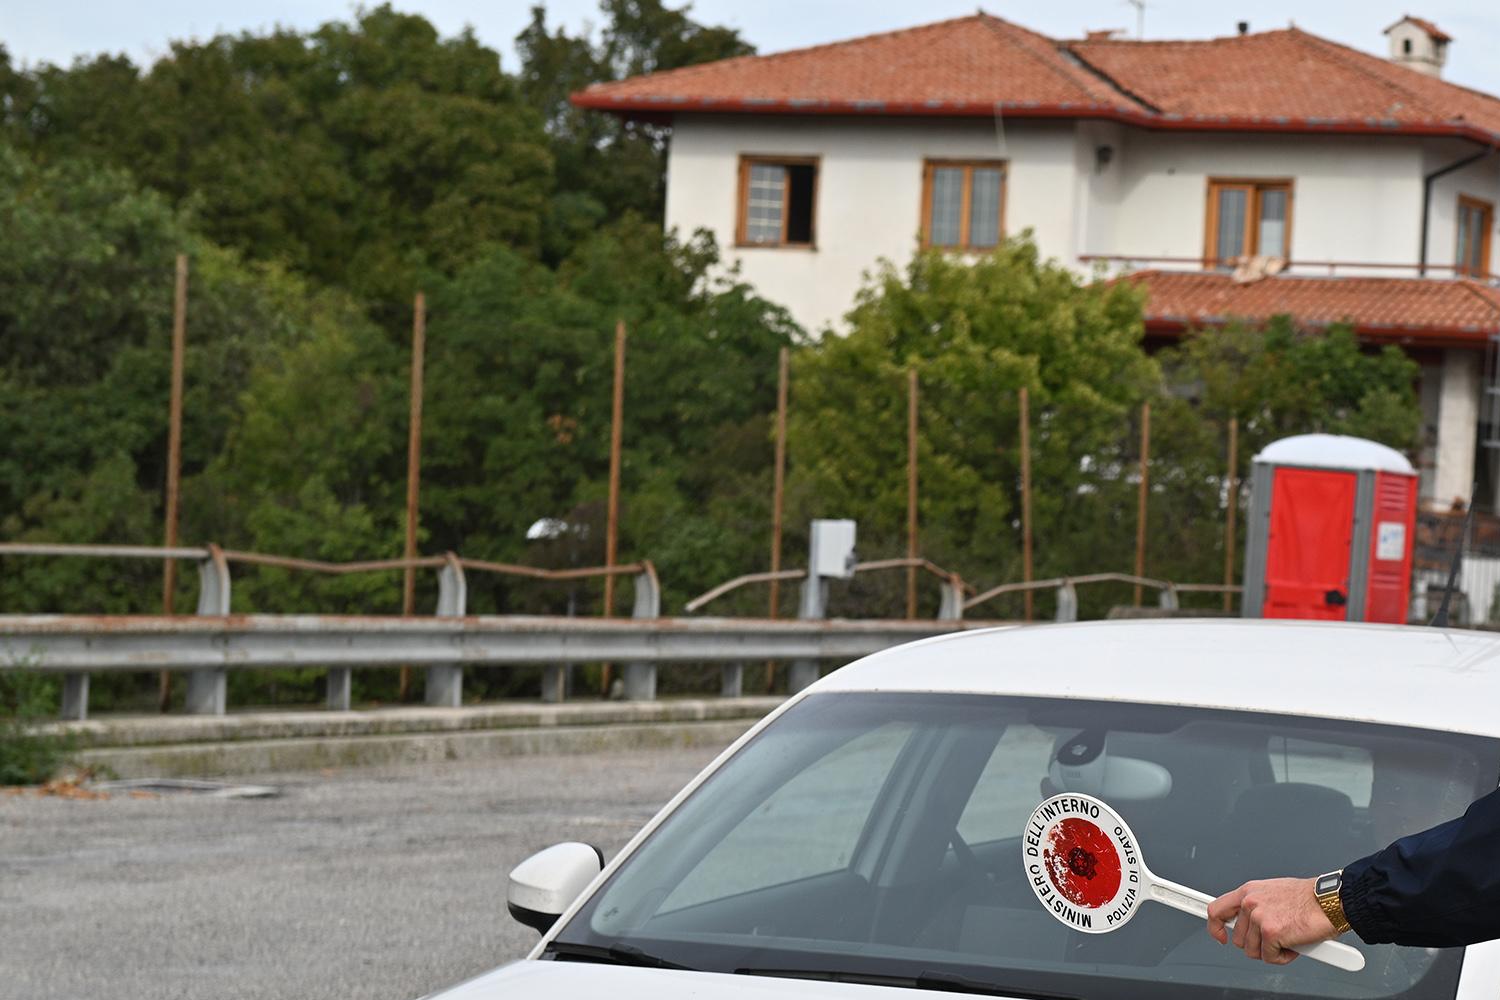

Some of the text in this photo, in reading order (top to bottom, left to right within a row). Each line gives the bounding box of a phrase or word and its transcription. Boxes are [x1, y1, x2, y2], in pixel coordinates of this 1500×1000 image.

[1027, 799, 1100, 928] MINISTERO DELL'INTERNO
[1107, 826, 1138, 925] POLIZIA DI STATO
